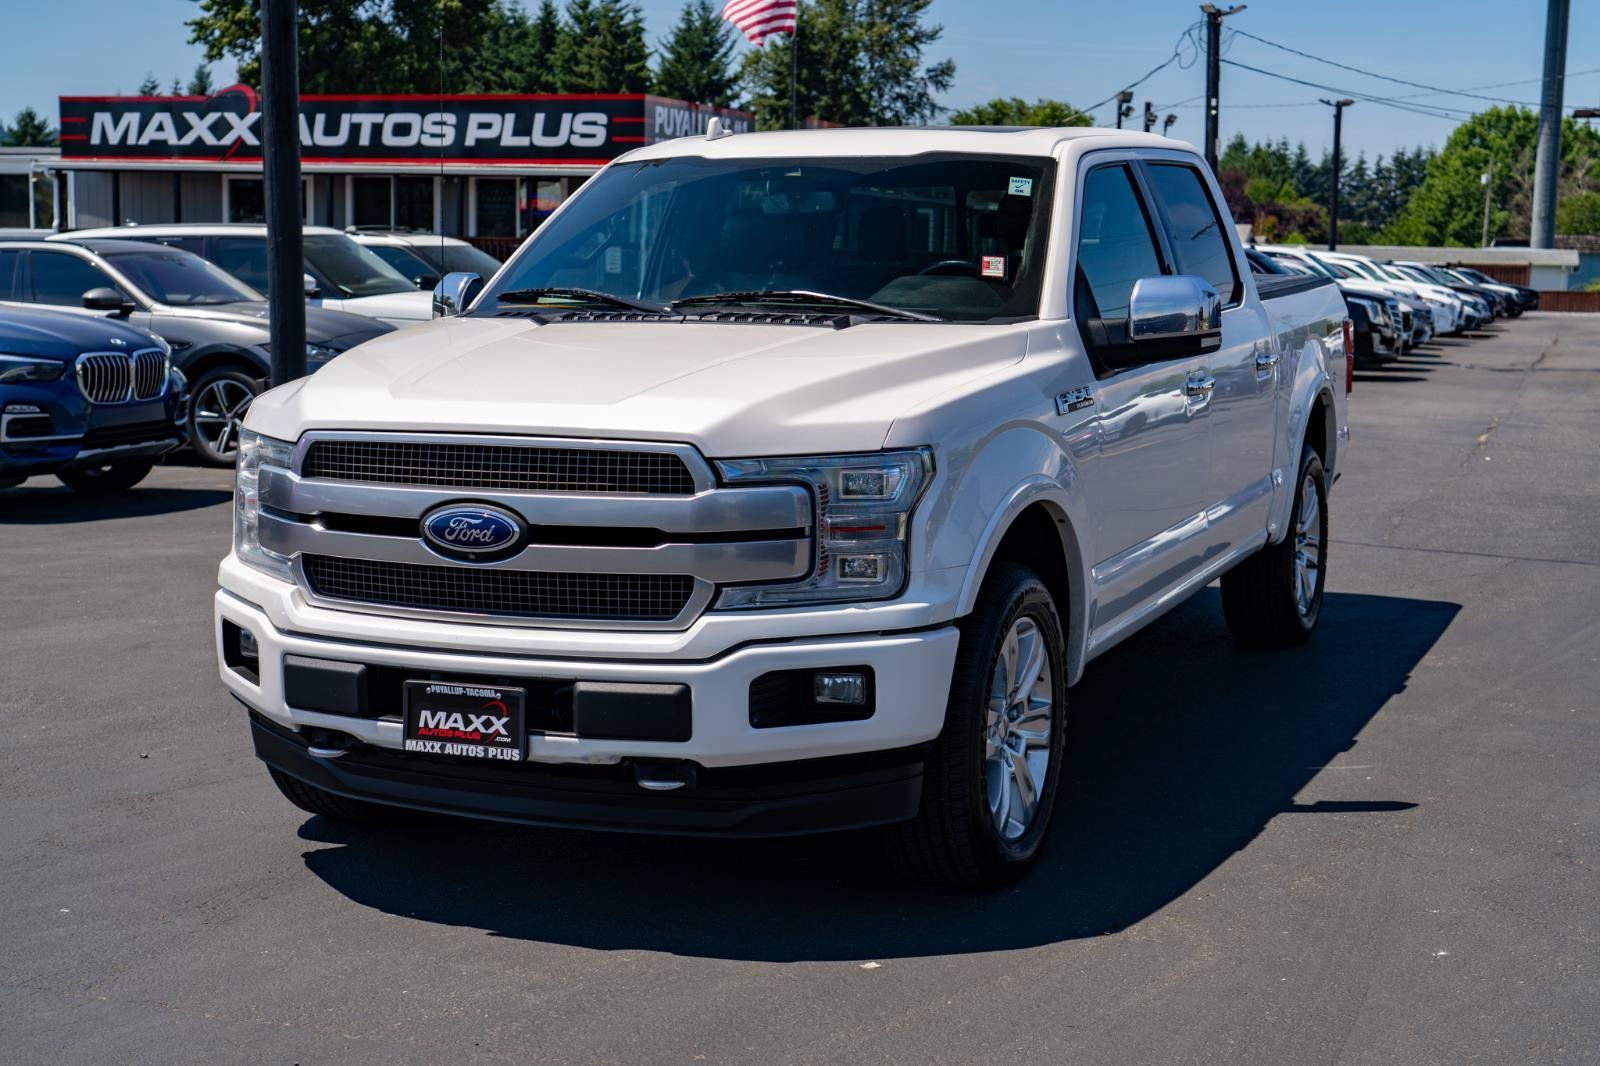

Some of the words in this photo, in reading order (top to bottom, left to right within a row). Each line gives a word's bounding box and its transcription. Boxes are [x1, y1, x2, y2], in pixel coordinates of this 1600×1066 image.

[90, 112, 262, 146] MAXX
[464, 112, 608, 147] PLUS
[445, 516, 495, 542] Ford
[431, 685, 496, 697] PUYALLUP-TACOMA
[418, 728, 453, 737] AUTOS
[455, 731, 481, 739] PLUS
[419, 710, 510, 735] MAXX
[405, 739, 441, 753] MAXX
[445, 743, 485, 757] AUTOS
[488, 747, 520, 761] PLUS
